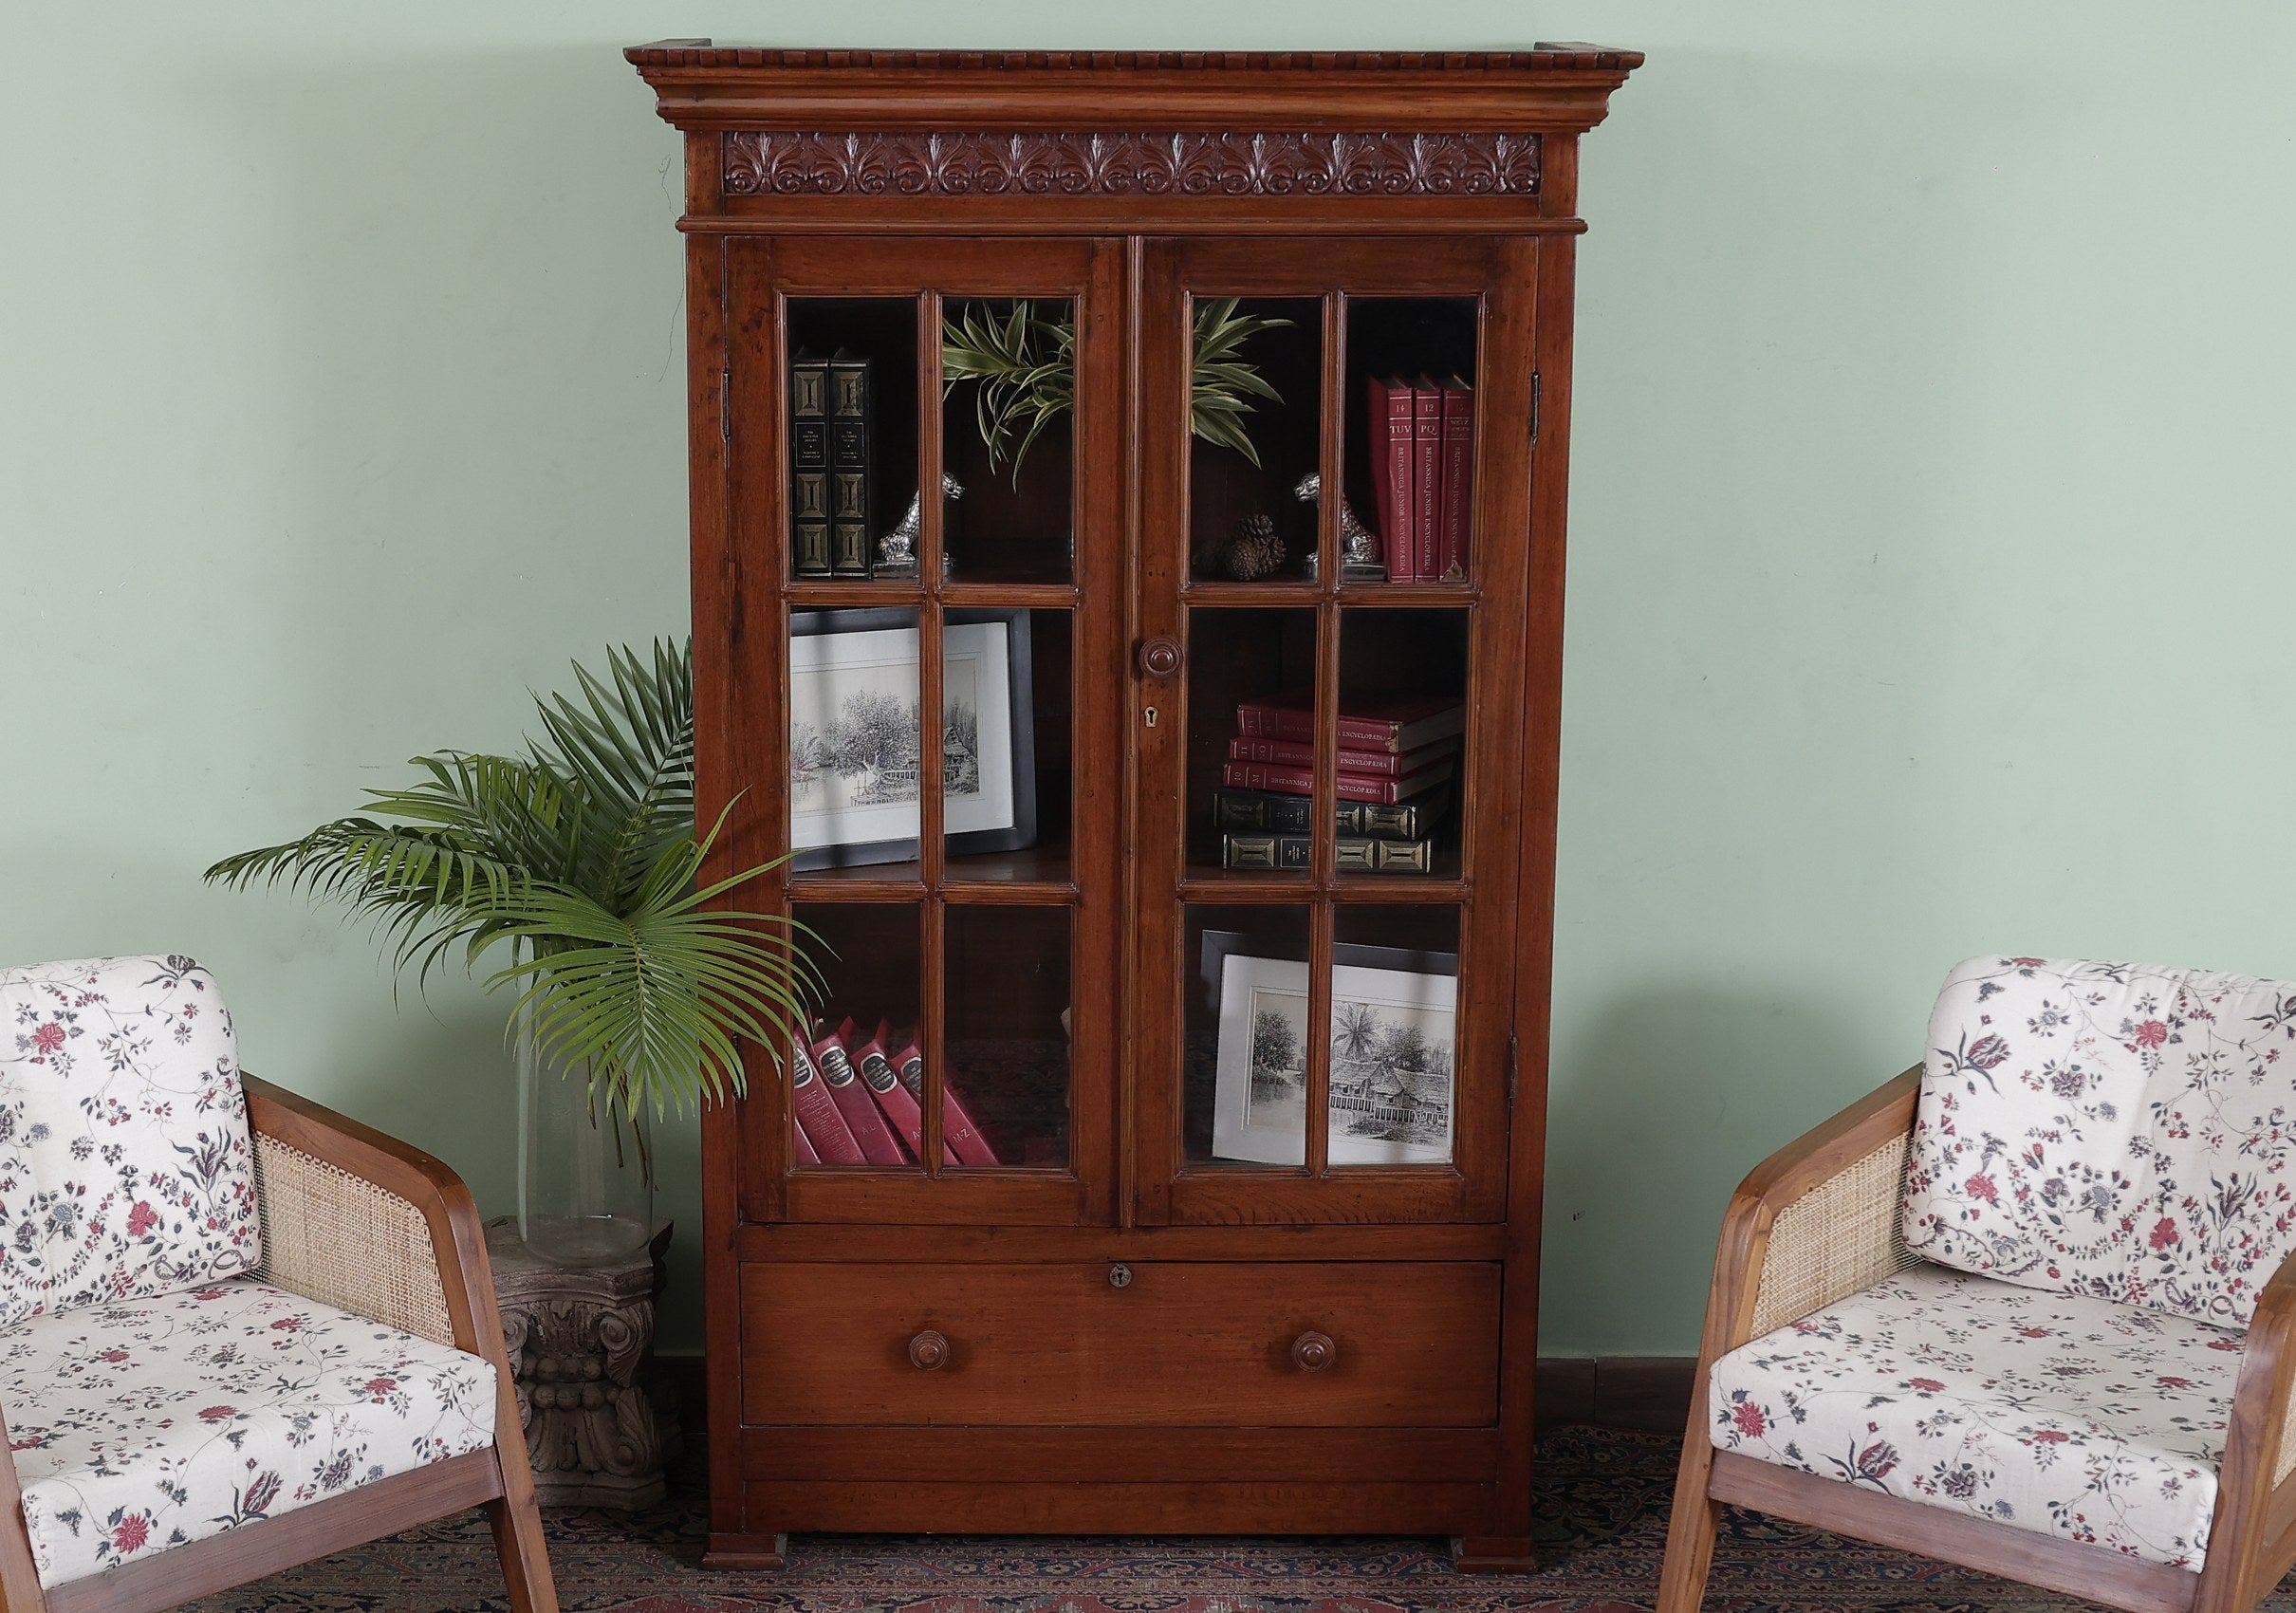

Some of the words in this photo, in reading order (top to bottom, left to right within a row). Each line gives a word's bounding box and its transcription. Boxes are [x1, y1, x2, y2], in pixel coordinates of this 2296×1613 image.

[1397, 404, 1405, 413] 14
[1425, 404, 1435, 413] 12
[1389, 424, 1412, 434] TUV
[1420, 424, 1437, 436] PQ
[1233, 770, 1241, 781] 10
[1336, 785, 1380, 795] NCYCLOPÆDIA
[953, 1128, 971, 1144] M-Z
